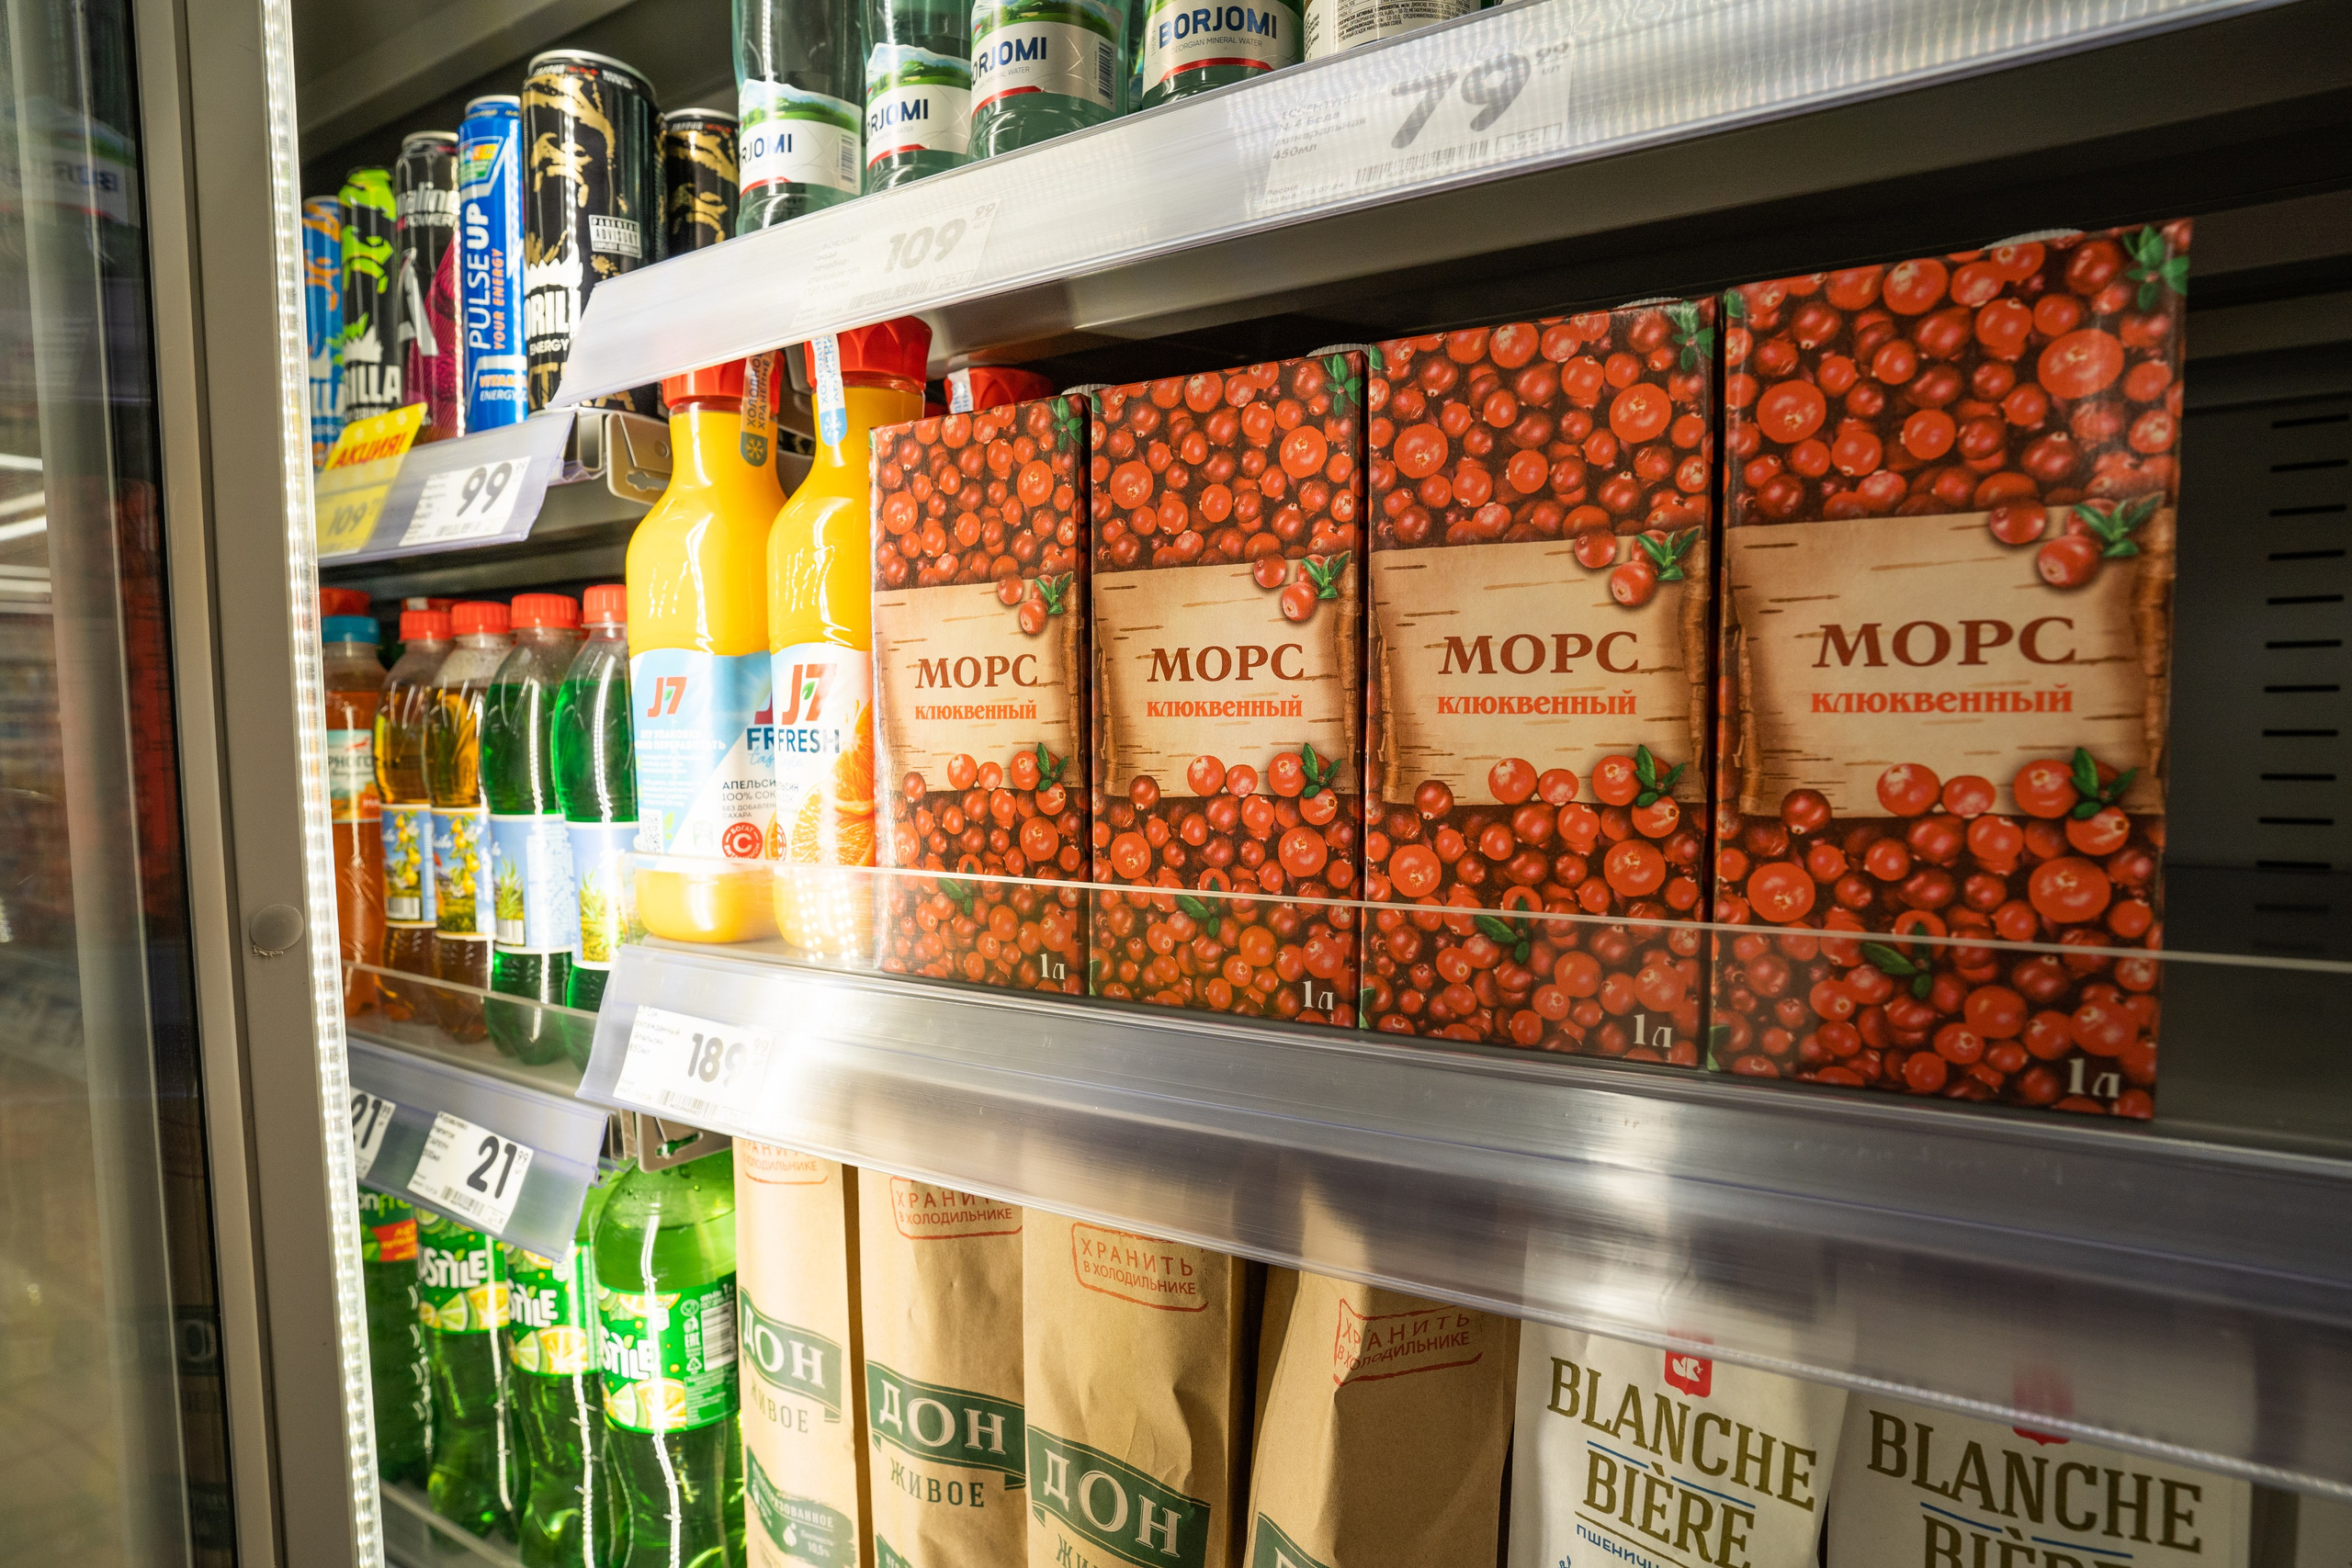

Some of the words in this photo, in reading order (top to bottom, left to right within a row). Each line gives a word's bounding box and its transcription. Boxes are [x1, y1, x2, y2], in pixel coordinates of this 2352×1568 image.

[1159, 6, 1277, 49] BORJOMI
[1170, 39, 1205, 55] GEORGIAN
[1206, 36, 1238, 45] MINERAL
[1238, 37, 1263, 48] WATER
[1008, 66, 1030, 76] WATER
[1391, 52, 1531, 149] 79
[1272, 143, 1317, 161] 450мл
[885, 218, 967, 274] 109
[975, 201, 997, 219] 99
[492, 247, 505, 302] ENERGY
[529, 339, 570, 356] ENERGY
[329, 431, 408, 469] АКЦИЯ!
[457, 462, 513, 518] 99
[1438, 631, 1640, 675] МОРС
[1811, 615, 2078, 669] МОРС
[915, 653, 1038, 690] МОРС
[1147, 643, 1305, 682] МОРС
[647, 676, 687, 717] J7
[781, 662, 838, 726] J7
[915, 699, 1037, 720] клюквенный
[1147, 694, 1303, 719] клюквенный
[1437, 690, 1637, 715] клюквенный
[1811, 684, 2074, 714] клюквенный
[777, 728, 840, 753] FRESH
[722, 779, 775, 791] АПЕЛЬСИ
[722, 793, 753, 802] 100%
[755, 791, 775, 800] СОК
[730, 825, 754, 837] БОГАТ
[687, 1032, 748, 1089] 189
[466, 1135, 518, 1200] 21
[515, 1149, 529, 1164] 99
[897, 1190, 1006, 1209] ХРАНИ
[906, 1207, 1012, 1226] ХОЛОДИЛЬНИКЕ
[1080, 1237, 1194, 1277] ХРАНИТЬ
[1083, 1260, 1091, 1274] В
[1092, 1262, 1196, 1296] ХОЛОДИЛЬНИКЕ
[742, 1303, 826, 1390] ДОН
[1338, 1344, 1344, 1361] В
[1344, 1331, 1470, 1371] ХОЛОДИЛЬНИКЕ
[1341, 1313, 1471, 1351] ХРАНИТЬ
[749, 1377, 809, 1434] ЖИВОЕ
[879, 1379, 1007, 1455] ДОН
[1547, 1355, 1818, 1513] BLANCHE
[889, 1457, 985, 1508] ЖИВОЕ
[1866, 1408, 2203, 1554] BLANCHE
[1044, 1447, 1182, 1559] ДОН
[1582, 1461, 1757, 1568] BIÈRE
